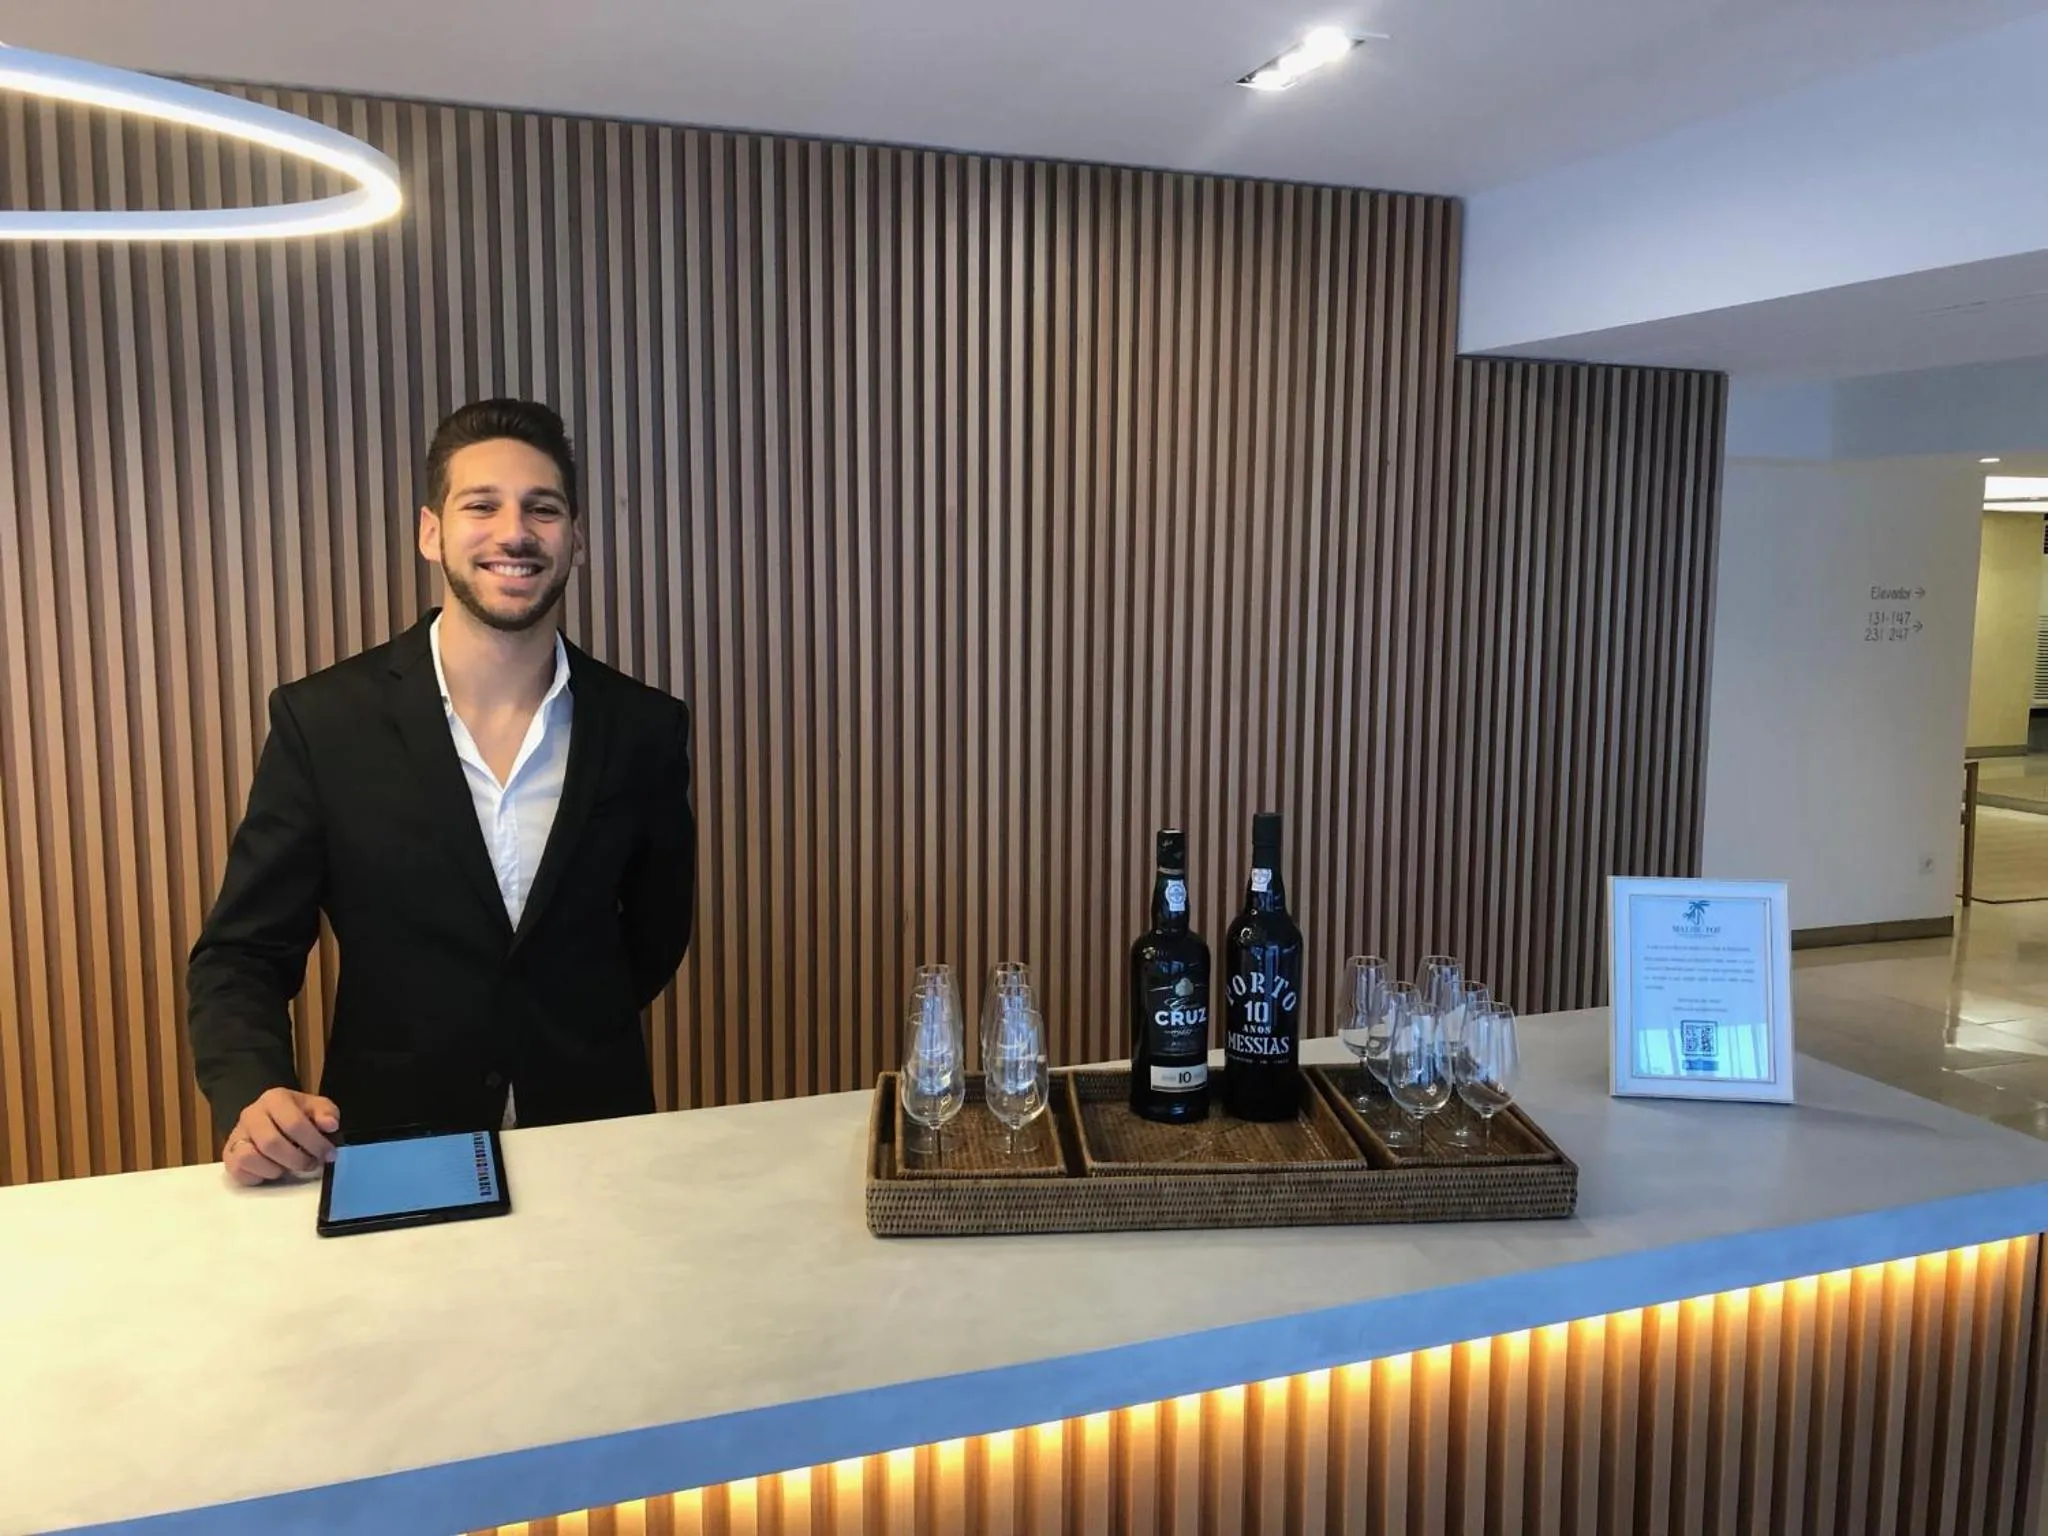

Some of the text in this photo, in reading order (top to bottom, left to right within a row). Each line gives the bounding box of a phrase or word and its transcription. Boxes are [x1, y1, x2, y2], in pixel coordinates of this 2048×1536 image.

[1865, 627, 1909, 641] 231247
[1226, 972, 1296, 1011] PORTO
[1155, 1007, 1206, 1026] CRUZ
[1244, 1001, 1269, 1022] 10
[1228, 1031, 1289, 1054] MESSIAS
[1178, 1071, 1192, 1084] 10
